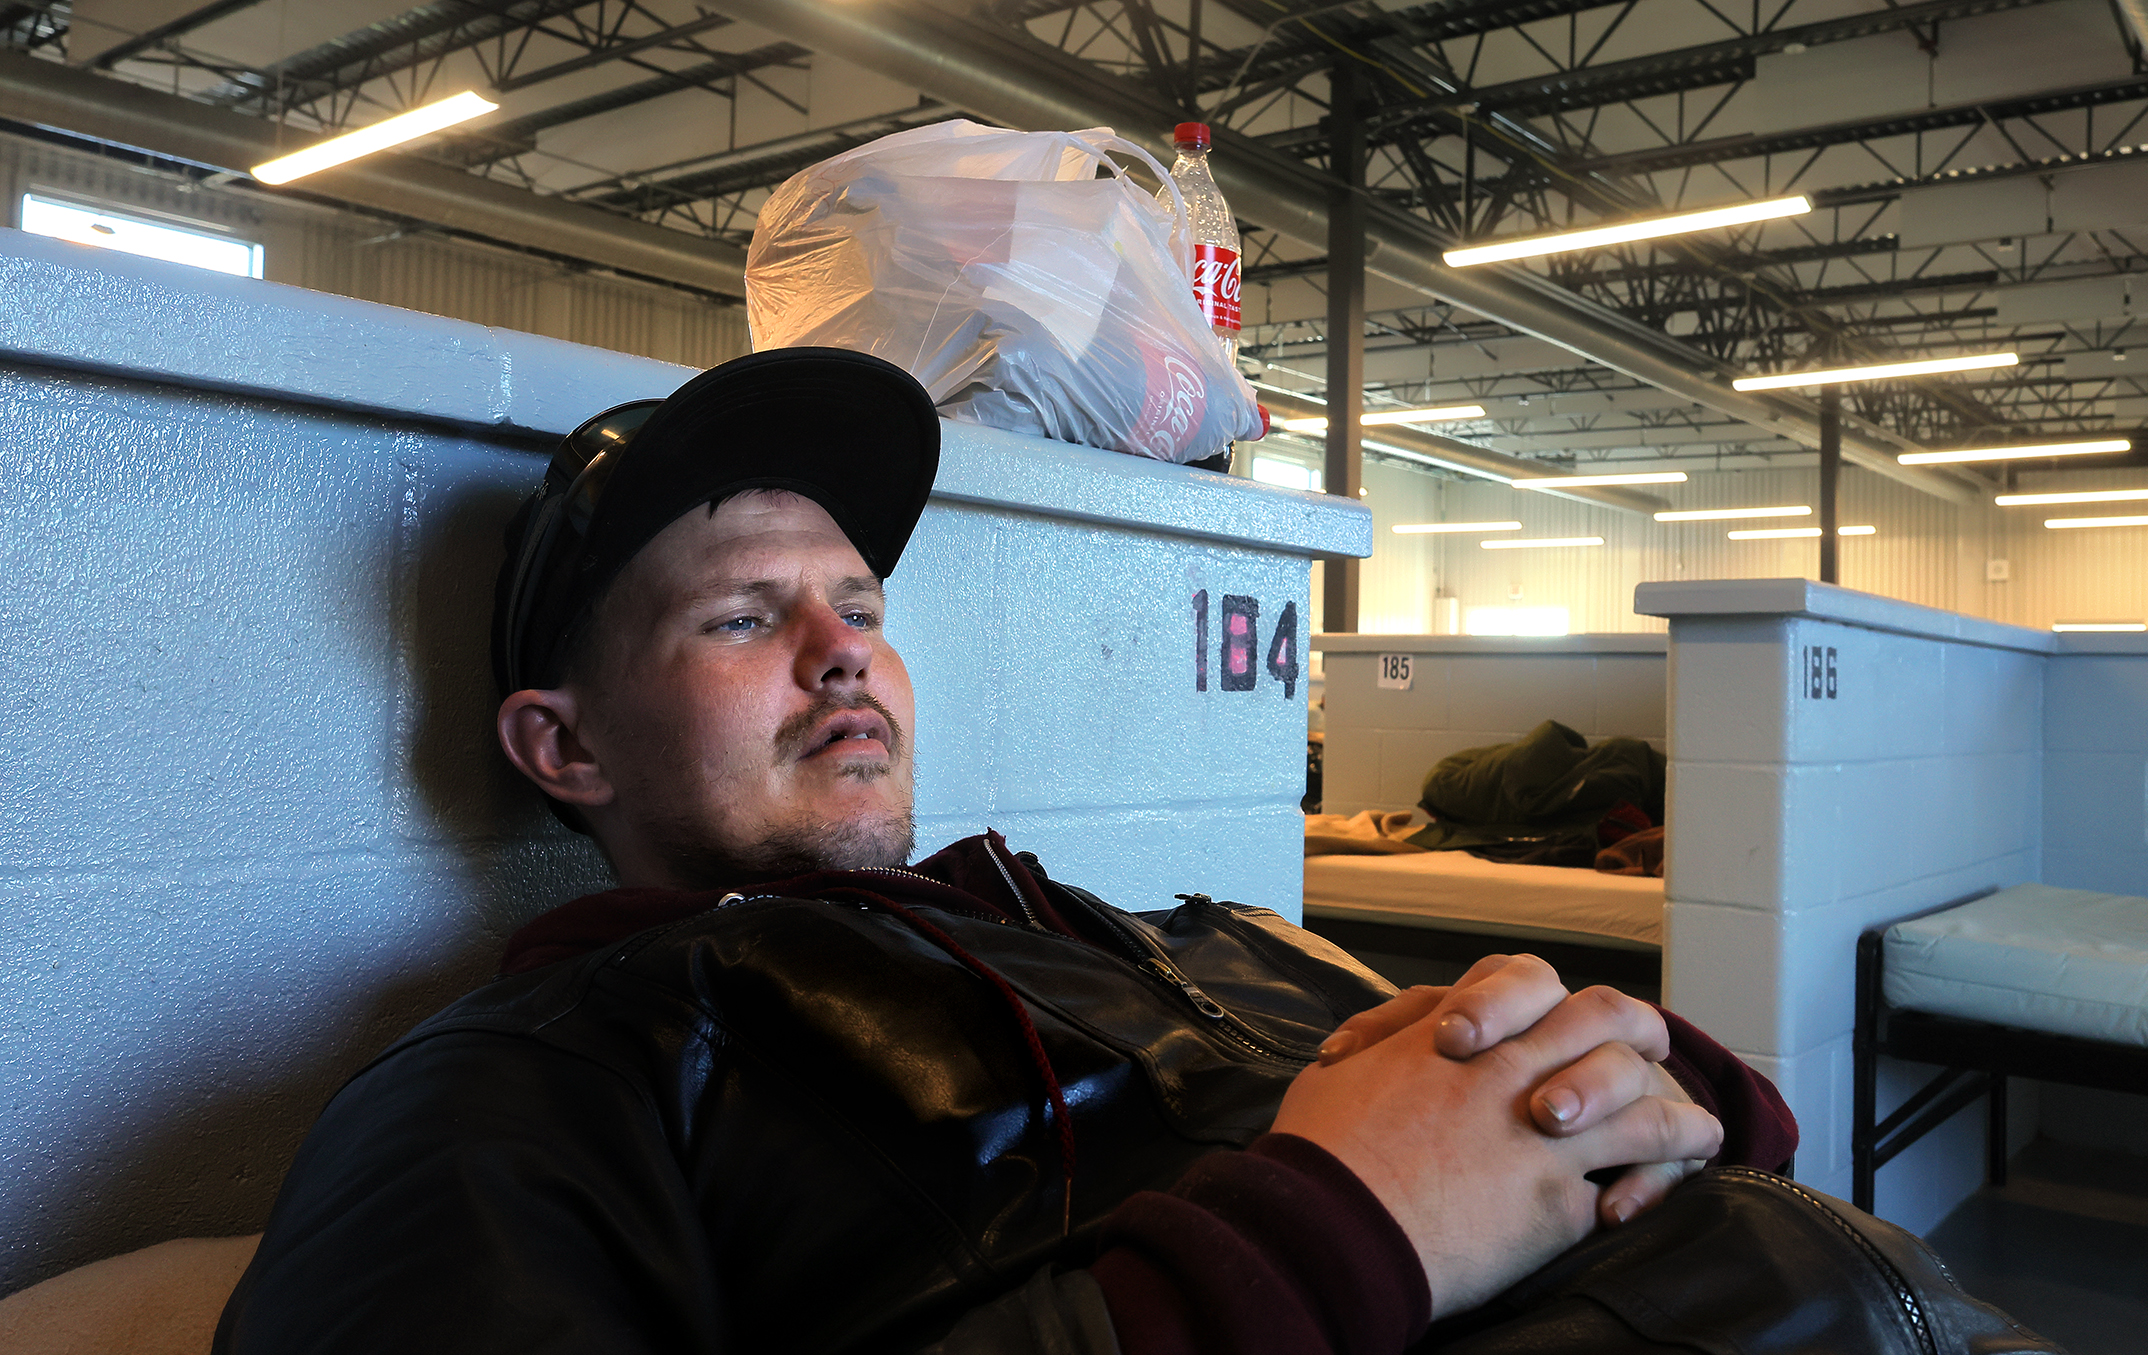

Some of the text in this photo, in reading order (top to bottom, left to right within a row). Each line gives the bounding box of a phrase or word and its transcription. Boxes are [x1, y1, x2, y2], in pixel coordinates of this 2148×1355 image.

[1149, 356, 1204, 462] Coca-C
[1192, 588, 1299, 700] 184
[1382, 656, 1410, 680] 185
[1803, 645, 1838, 700] 186
